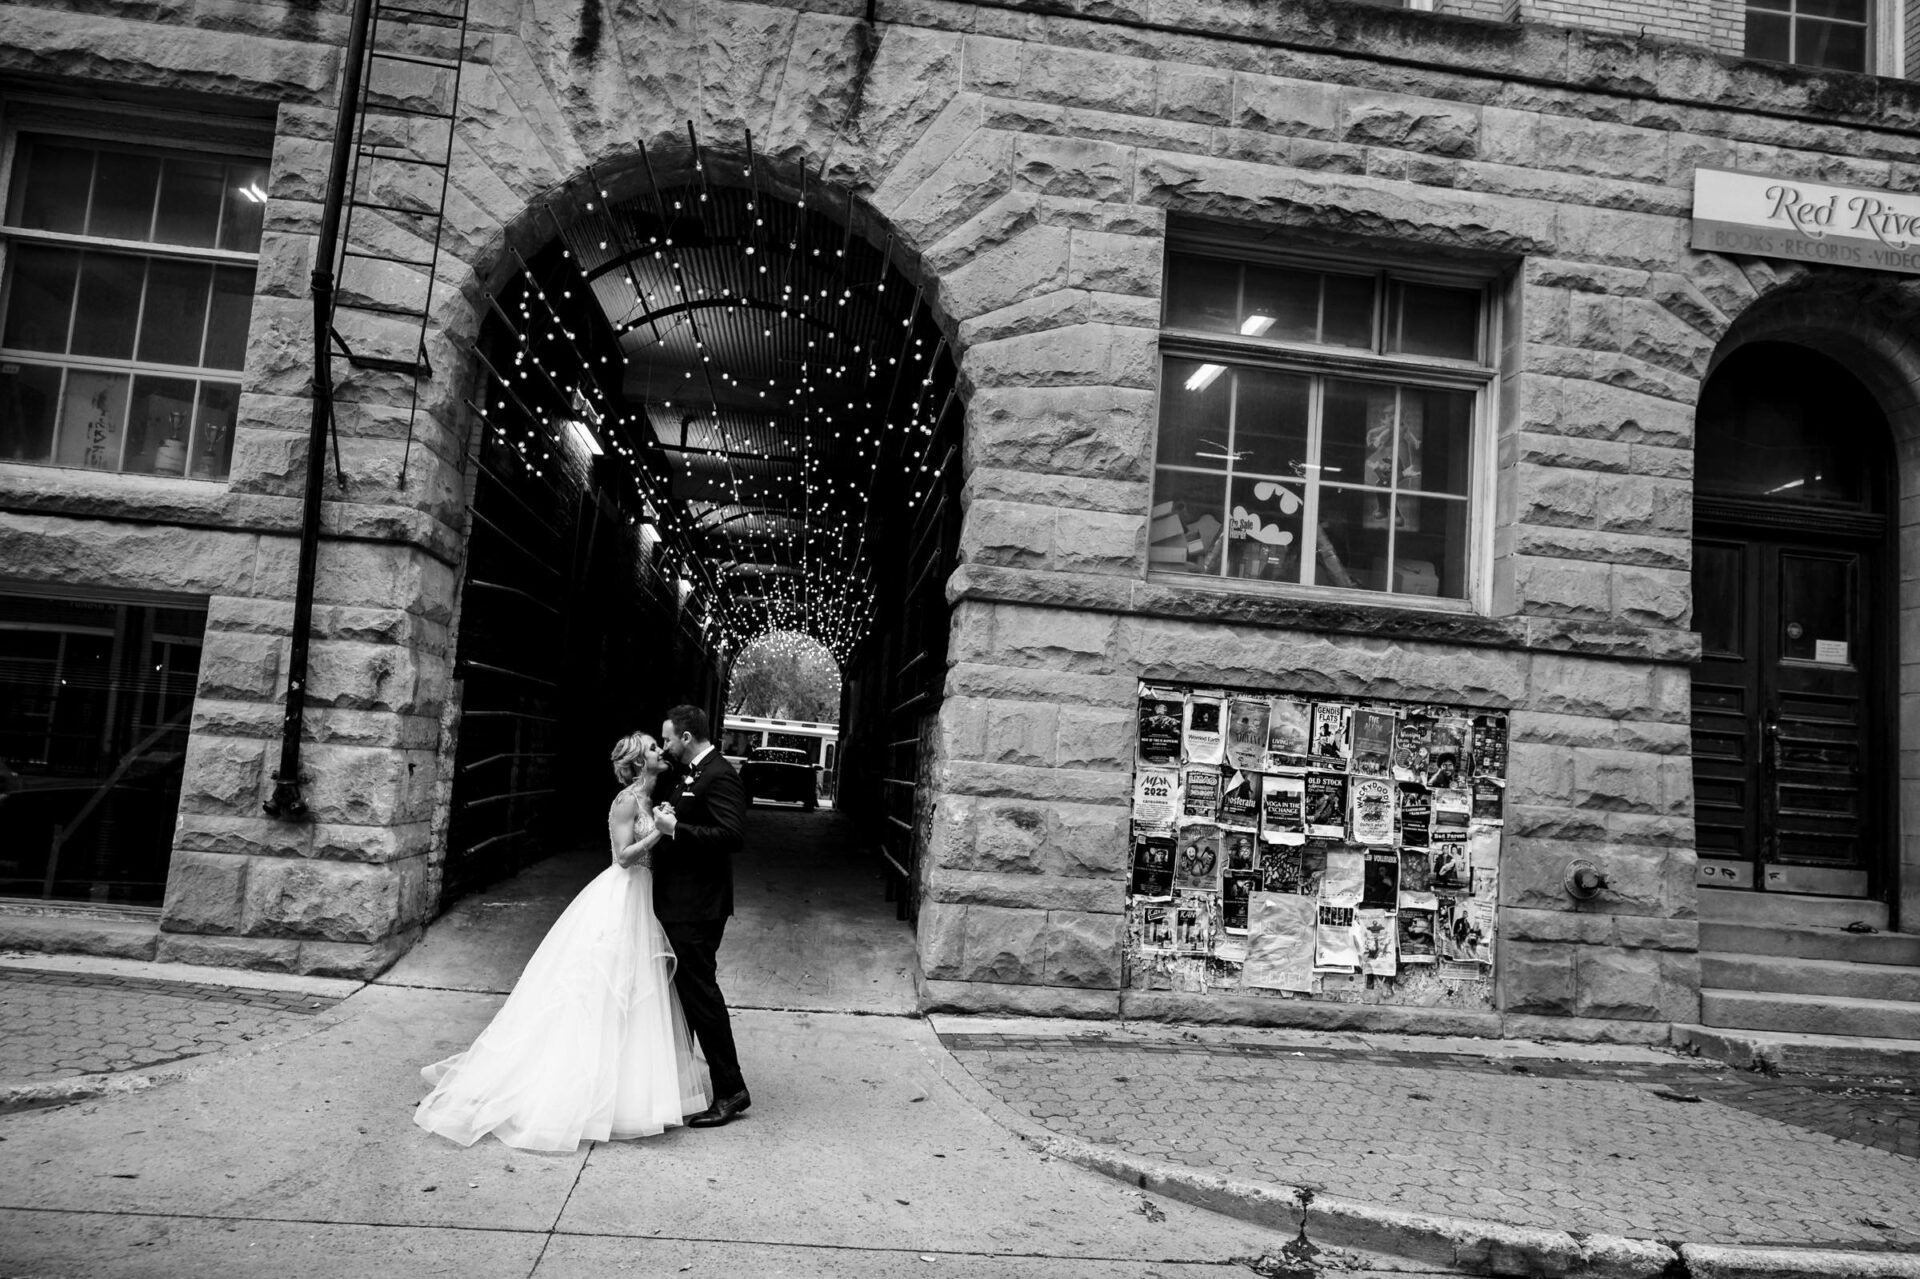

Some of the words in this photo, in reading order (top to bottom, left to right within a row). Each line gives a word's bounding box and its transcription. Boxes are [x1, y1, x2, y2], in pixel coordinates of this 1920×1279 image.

[1765, 185, 1839, 240] Red
[1848, 196, 1920, 250] Rive
[1715, 230, 1773, 252] BOOKS
[1785, 239, 1862, 262] RECORDS
[1240, 518, 1254, 530] Sale
[1319, 713, 1338, 722] FLATS
[1308, 777, 1321, 785] OLD
[1322, 778, 1343, 787] STOCK
[1144, 787, 1168, 797] 2022
